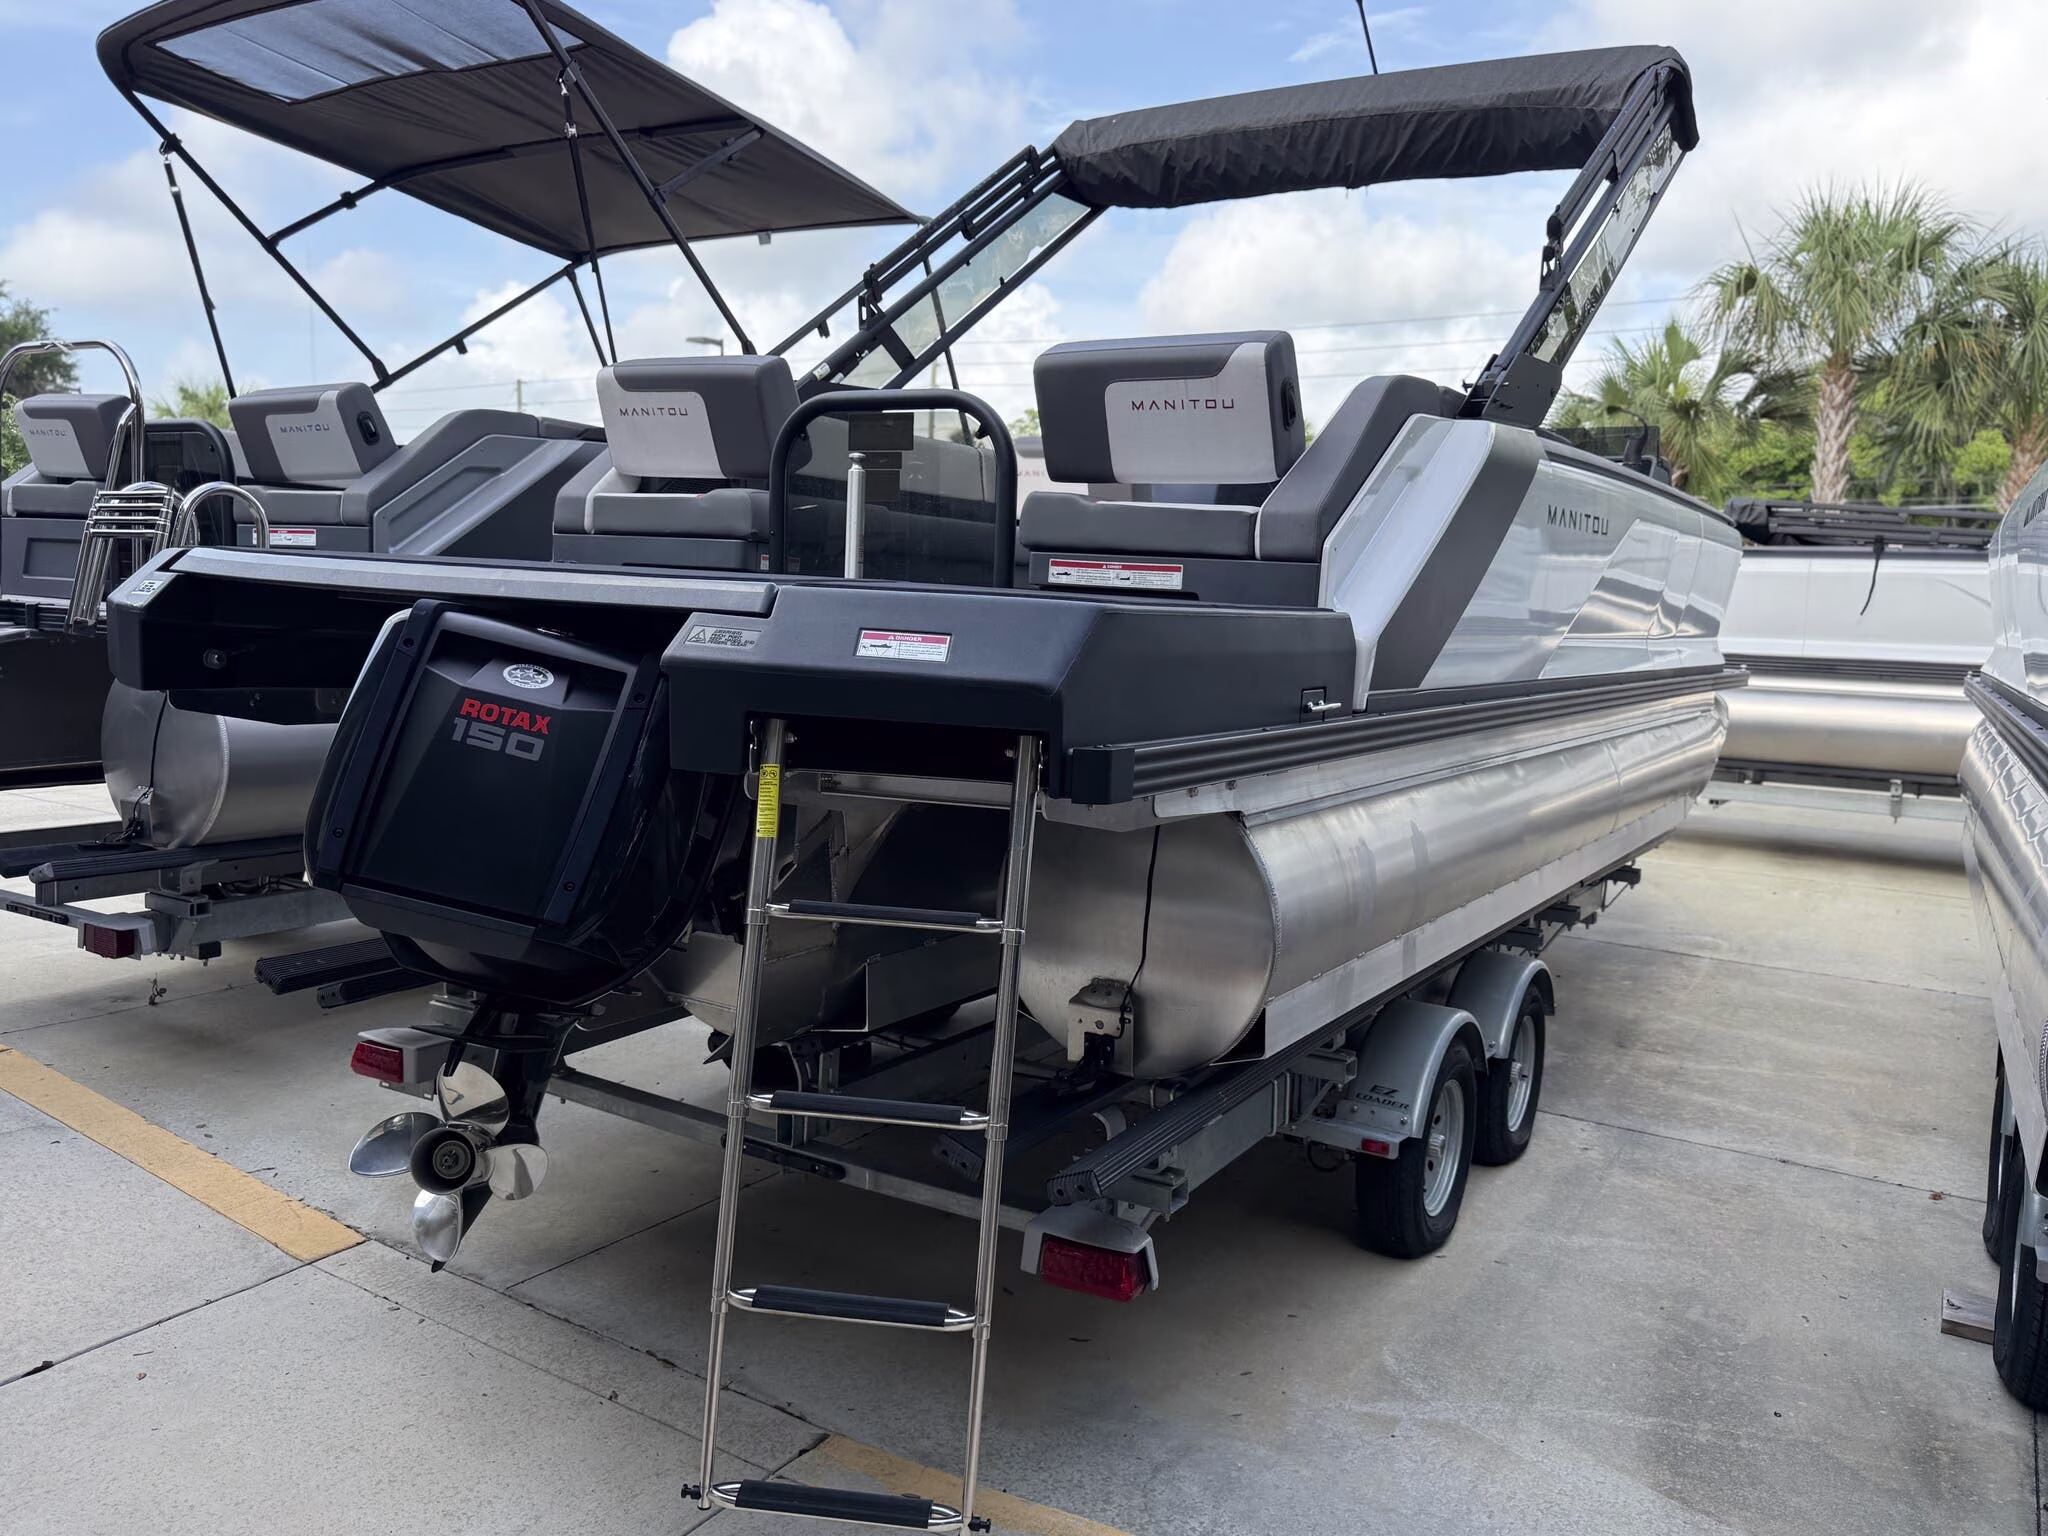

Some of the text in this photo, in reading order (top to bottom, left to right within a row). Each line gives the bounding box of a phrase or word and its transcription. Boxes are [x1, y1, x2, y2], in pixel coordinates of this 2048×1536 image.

[619, 407, 688, 417] MANITOU
[1131, 398, 1235, 411] MANITOU
[280, 423, 330, 433] MANITOU
[1547, 504, 1608, 535] MANITOU
[460, 698, 551, 735] ROTAX
[452, 717, 545, 761] 150
